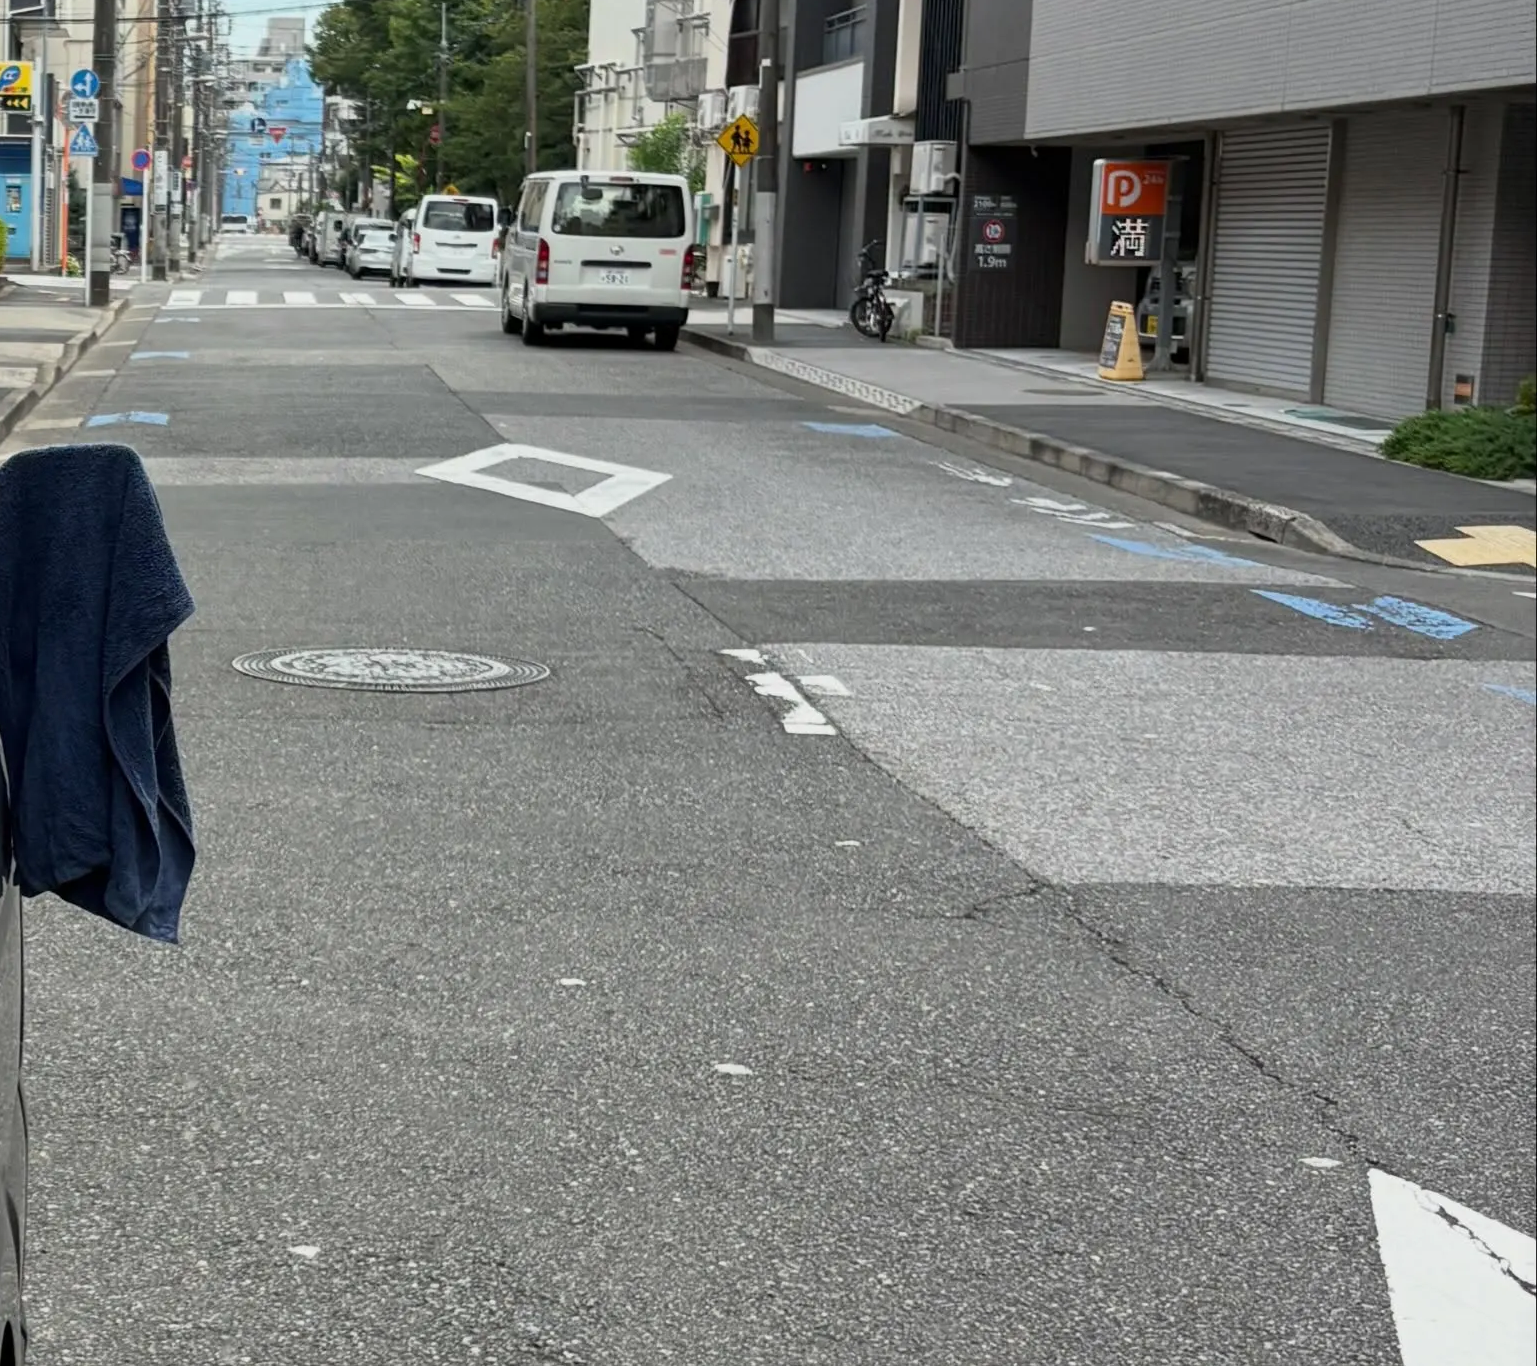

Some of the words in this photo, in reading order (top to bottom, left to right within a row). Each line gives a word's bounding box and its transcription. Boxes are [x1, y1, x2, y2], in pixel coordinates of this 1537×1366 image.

[1107, 169, 1142, 208] P
[1110, 218, 1150, 257] 満
[978, 255, 1007, 268] 1.9m
